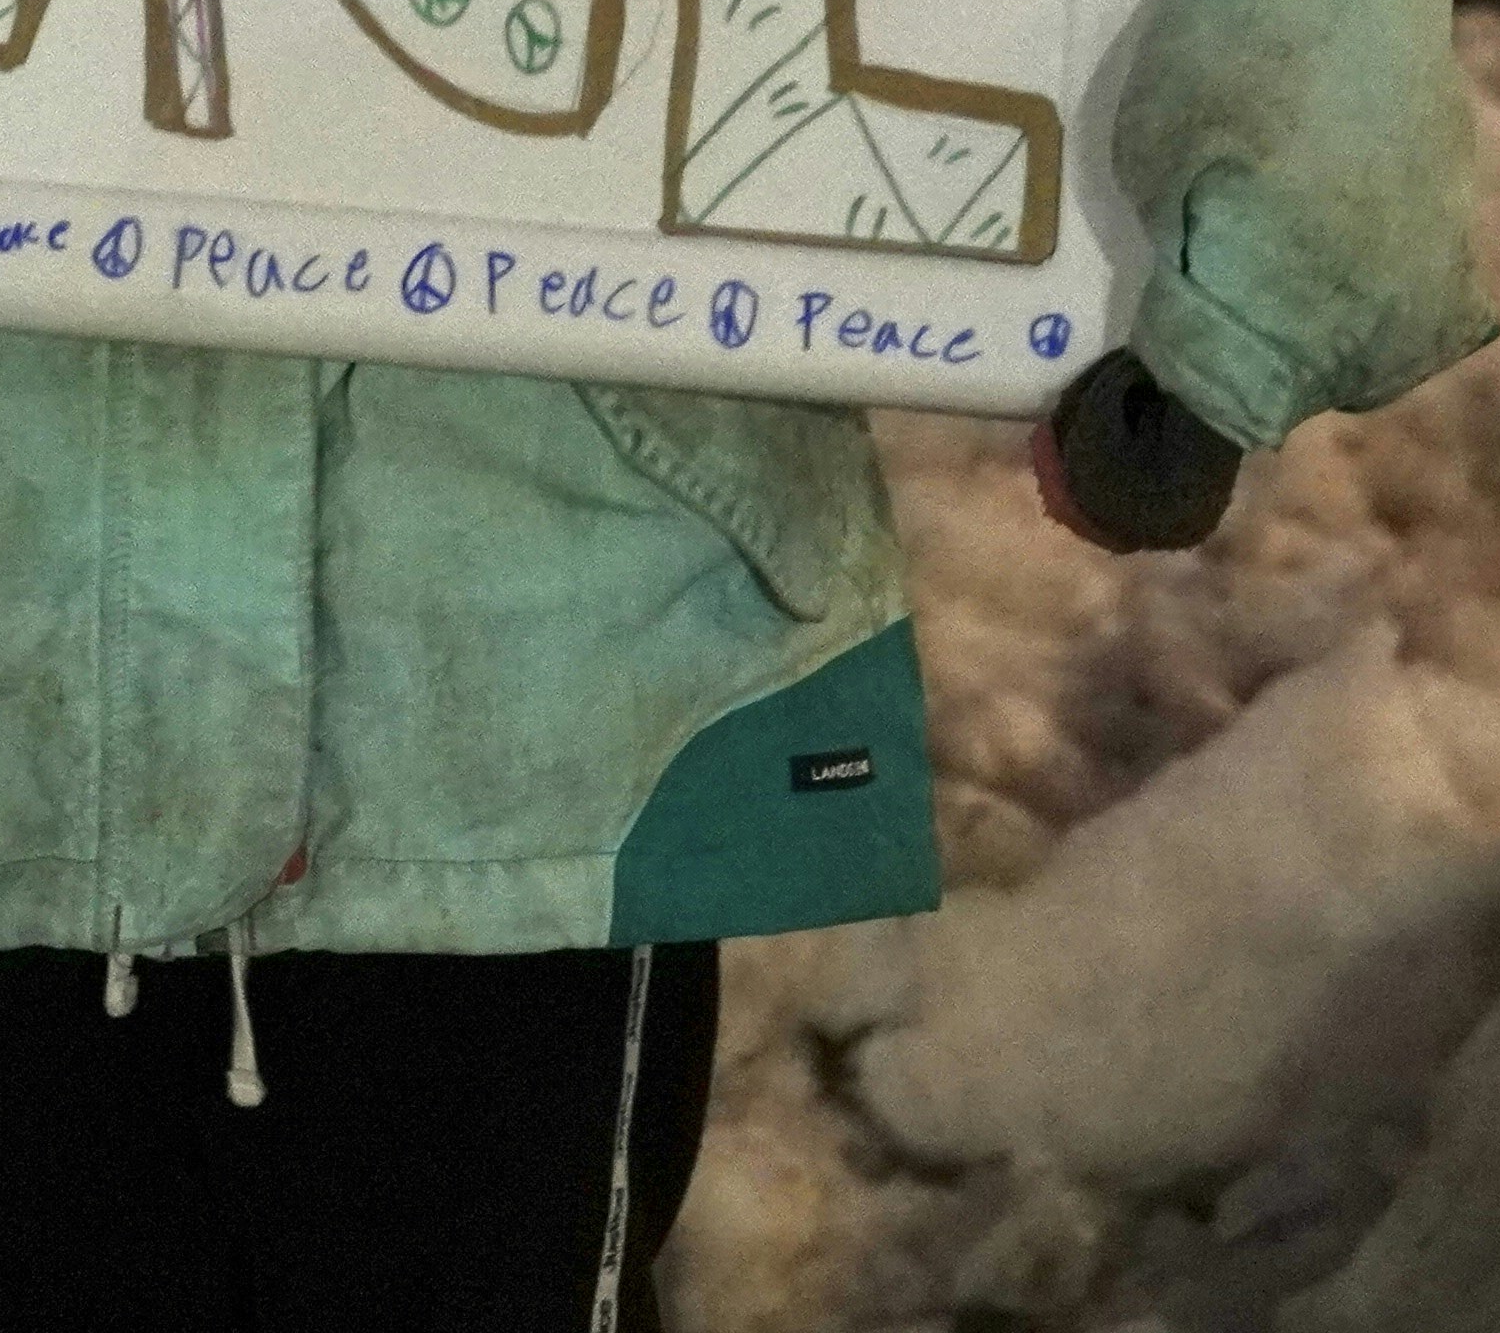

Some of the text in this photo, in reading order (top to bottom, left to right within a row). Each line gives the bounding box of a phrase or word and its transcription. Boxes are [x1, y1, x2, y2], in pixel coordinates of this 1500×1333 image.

[171, 225, 372, 296] Peace
[488, 250, 686, 326] Peace
[797, 290, 983, 364] Peace
